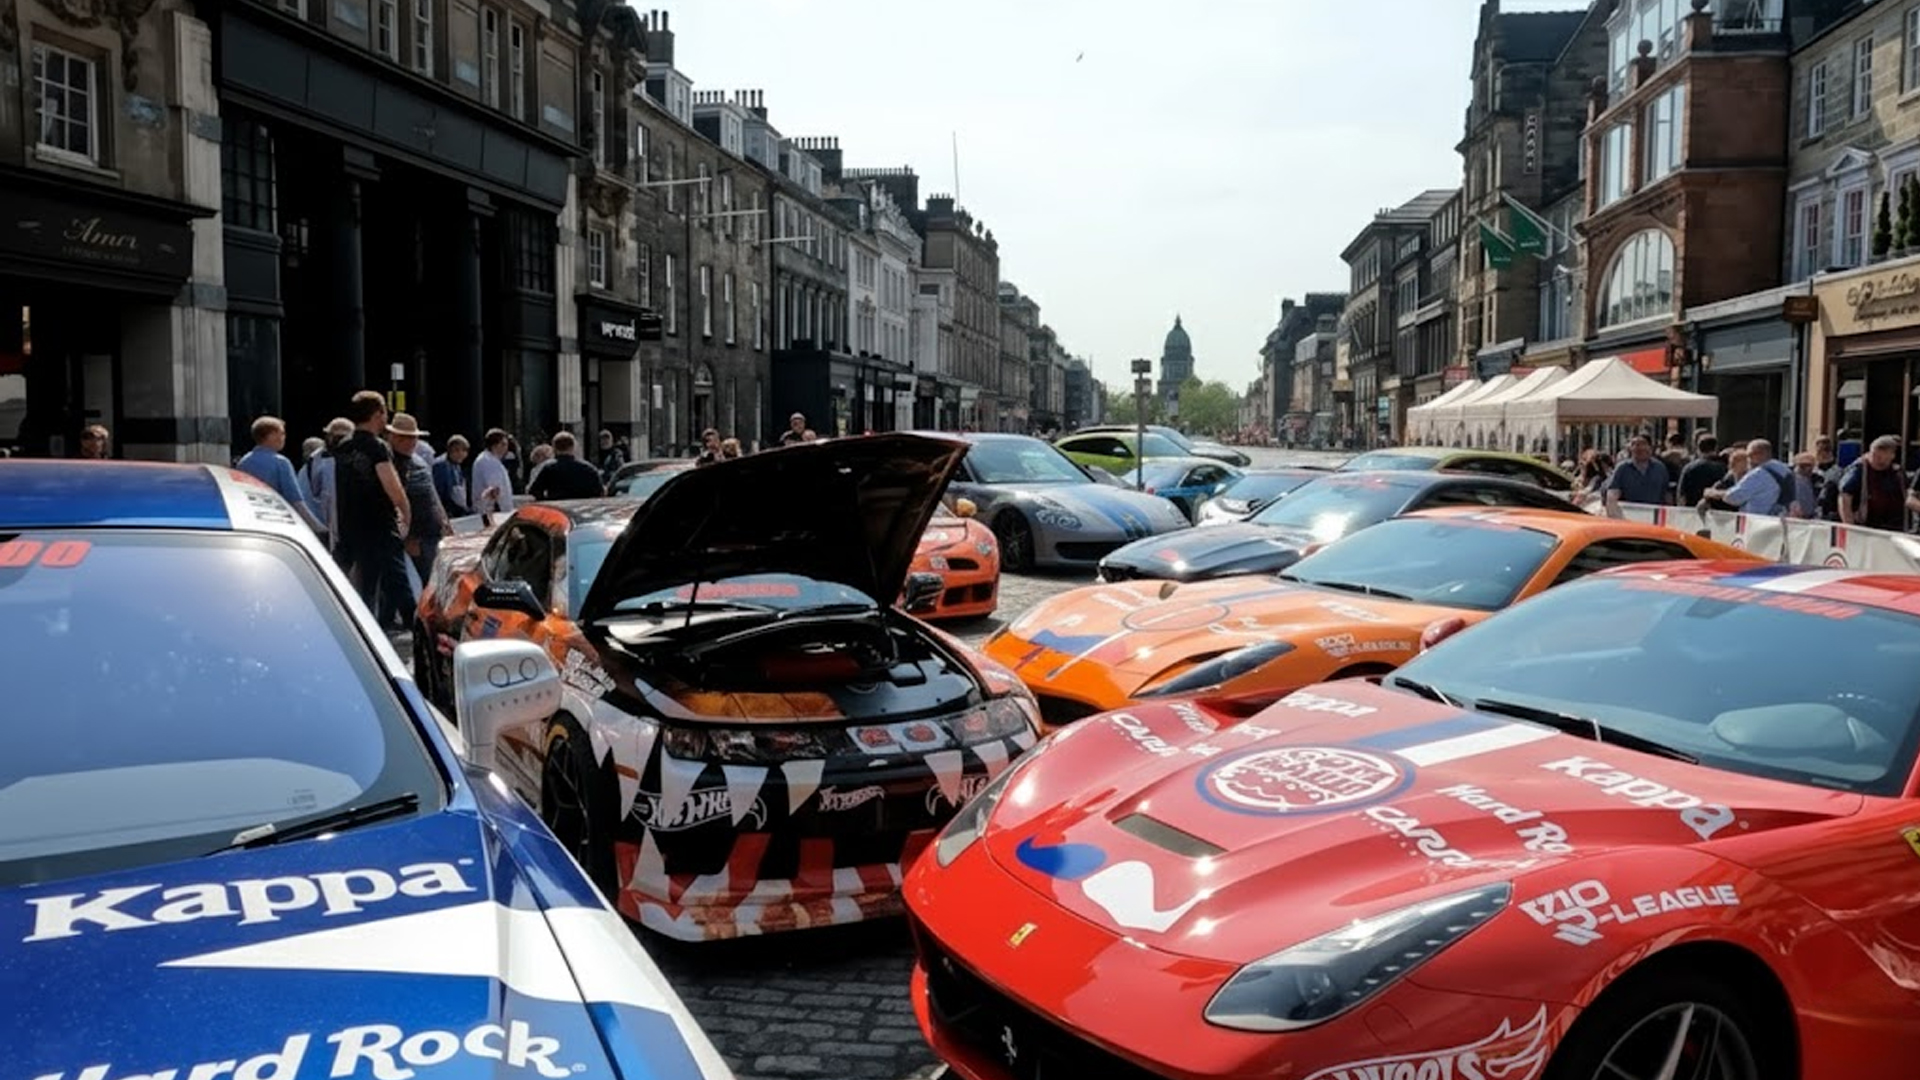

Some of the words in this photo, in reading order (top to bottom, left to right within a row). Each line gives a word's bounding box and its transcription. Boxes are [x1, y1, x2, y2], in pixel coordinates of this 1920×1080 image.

[1435, 784, 1544, 824] Hard
[1539, 756, 1736, 841] Kappa
[22, 862, 477, 943] Kappa
[326, 1021, 572, 1080] Rock
